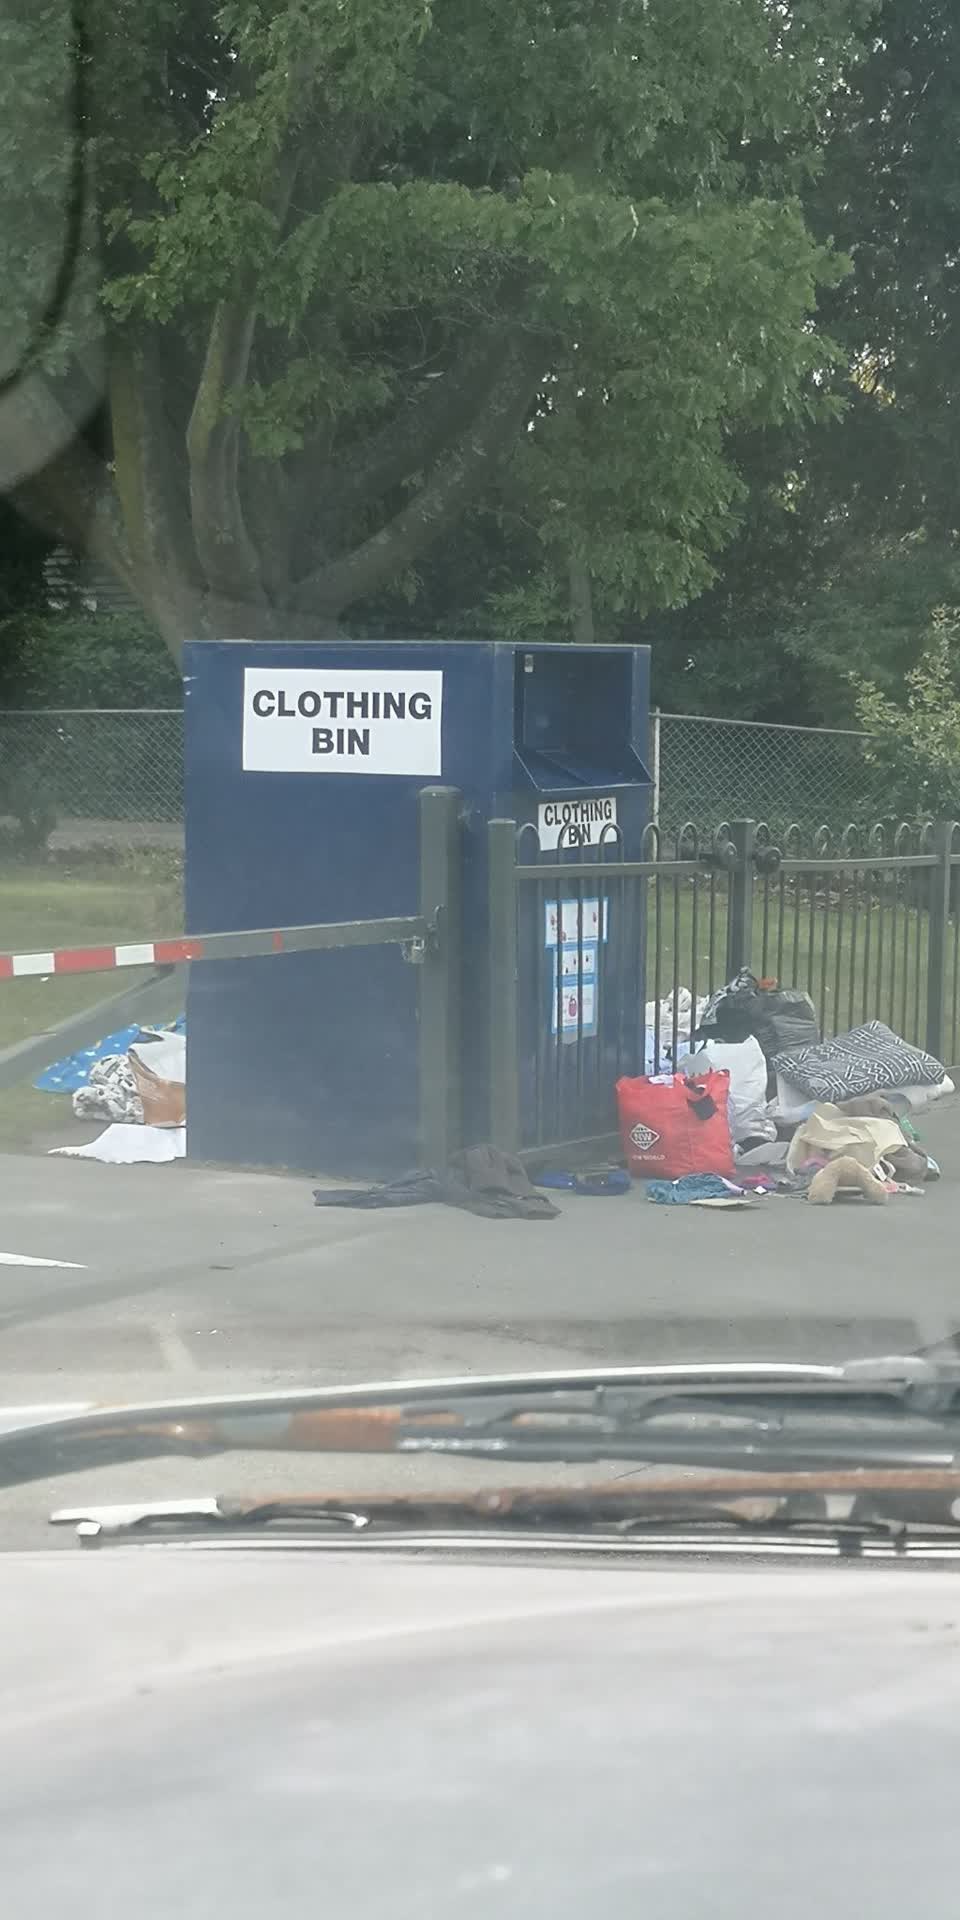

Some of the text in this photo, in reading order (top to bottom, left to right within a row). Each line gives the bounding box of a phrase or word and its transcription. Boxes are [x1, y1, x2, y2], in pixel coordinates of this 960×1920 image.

[252, 689, 432, 720] CLOTHING
[311, 727, 370, 755] BIN
[544, 800, 612, 826] CLOTHING
[568, 823, 591, 845] BN
